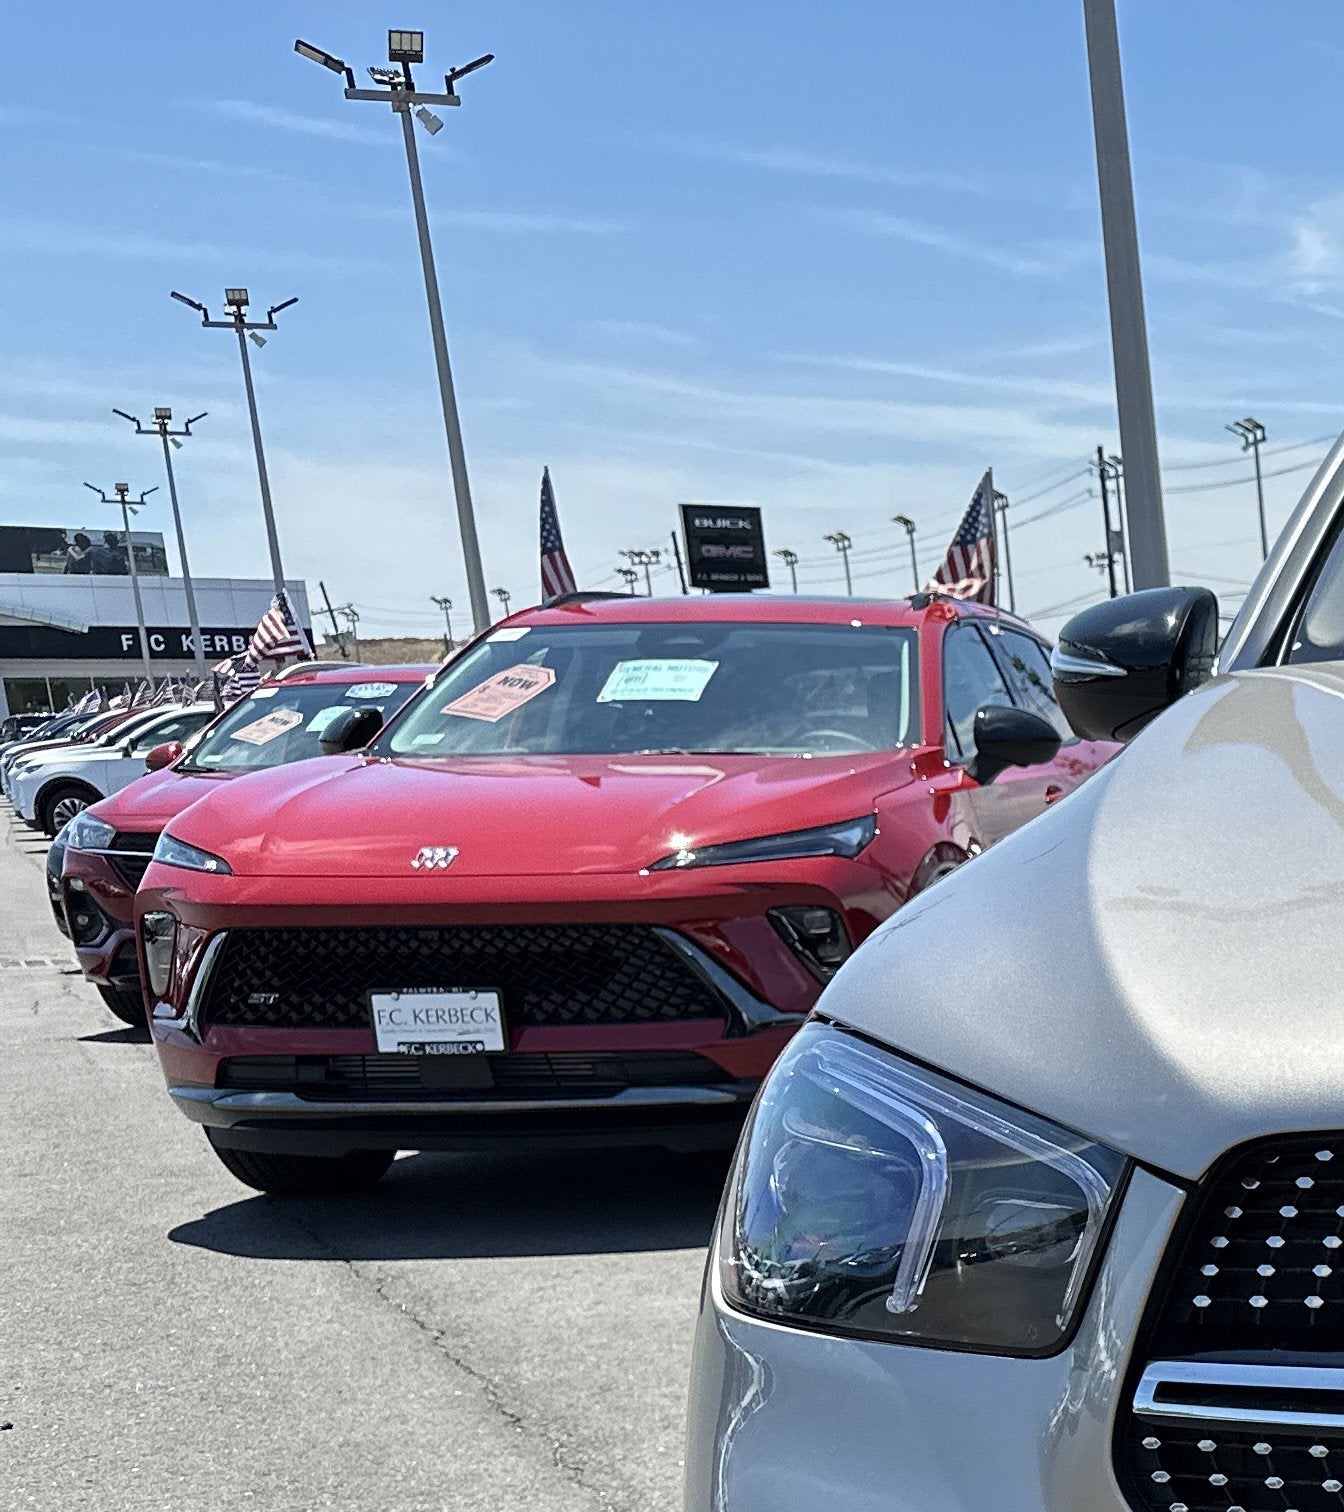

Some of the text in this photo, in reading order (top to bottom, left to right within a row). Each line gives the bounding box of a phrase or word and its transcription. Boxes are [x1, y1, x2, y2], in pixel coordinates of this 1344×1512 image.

[694, 517, 753, 530] BUICK
[702, 544, 754, 558] GMC
[120, 634, 133, 651] F
[150, 634, 166, 651] C
[496, 676, 540, 690] NOW
[412, 1007, 497, 1025] KERBECK
[425, 1042, 477, 1055] KERBECK
